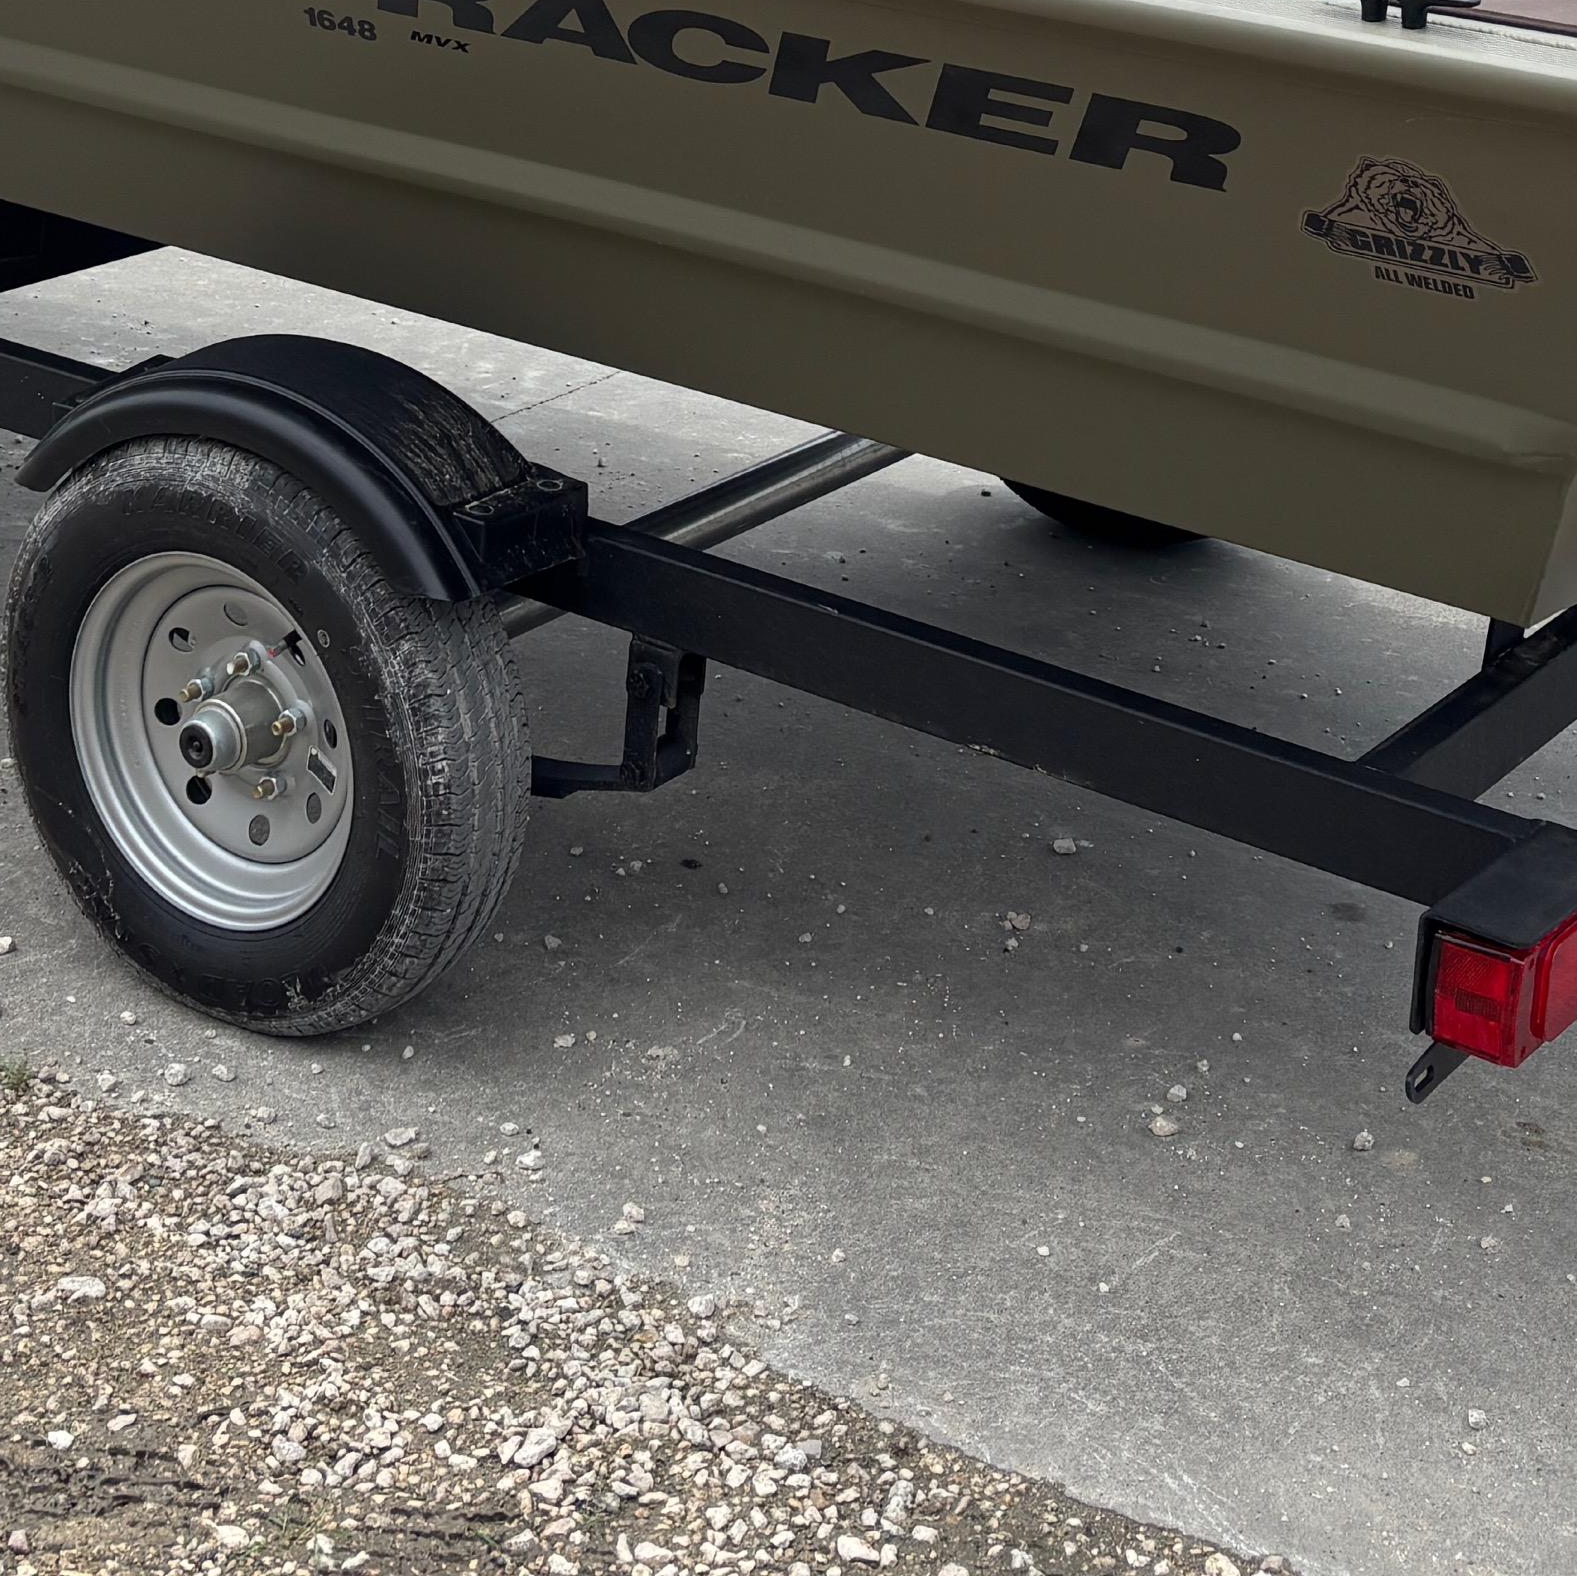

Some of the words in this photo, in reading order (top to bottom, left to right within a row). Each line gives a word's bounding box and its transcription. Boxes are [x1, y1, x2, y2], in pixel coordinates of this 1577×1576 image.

[303, 7, 377, 41] 1648
[410, 30, 471, 54] MVX
[1349, 228, 1489, 276] GRIZZLY
[1374, 265, 1404, 285] ALL
[1405, 272, 1476, 300] WELDED
